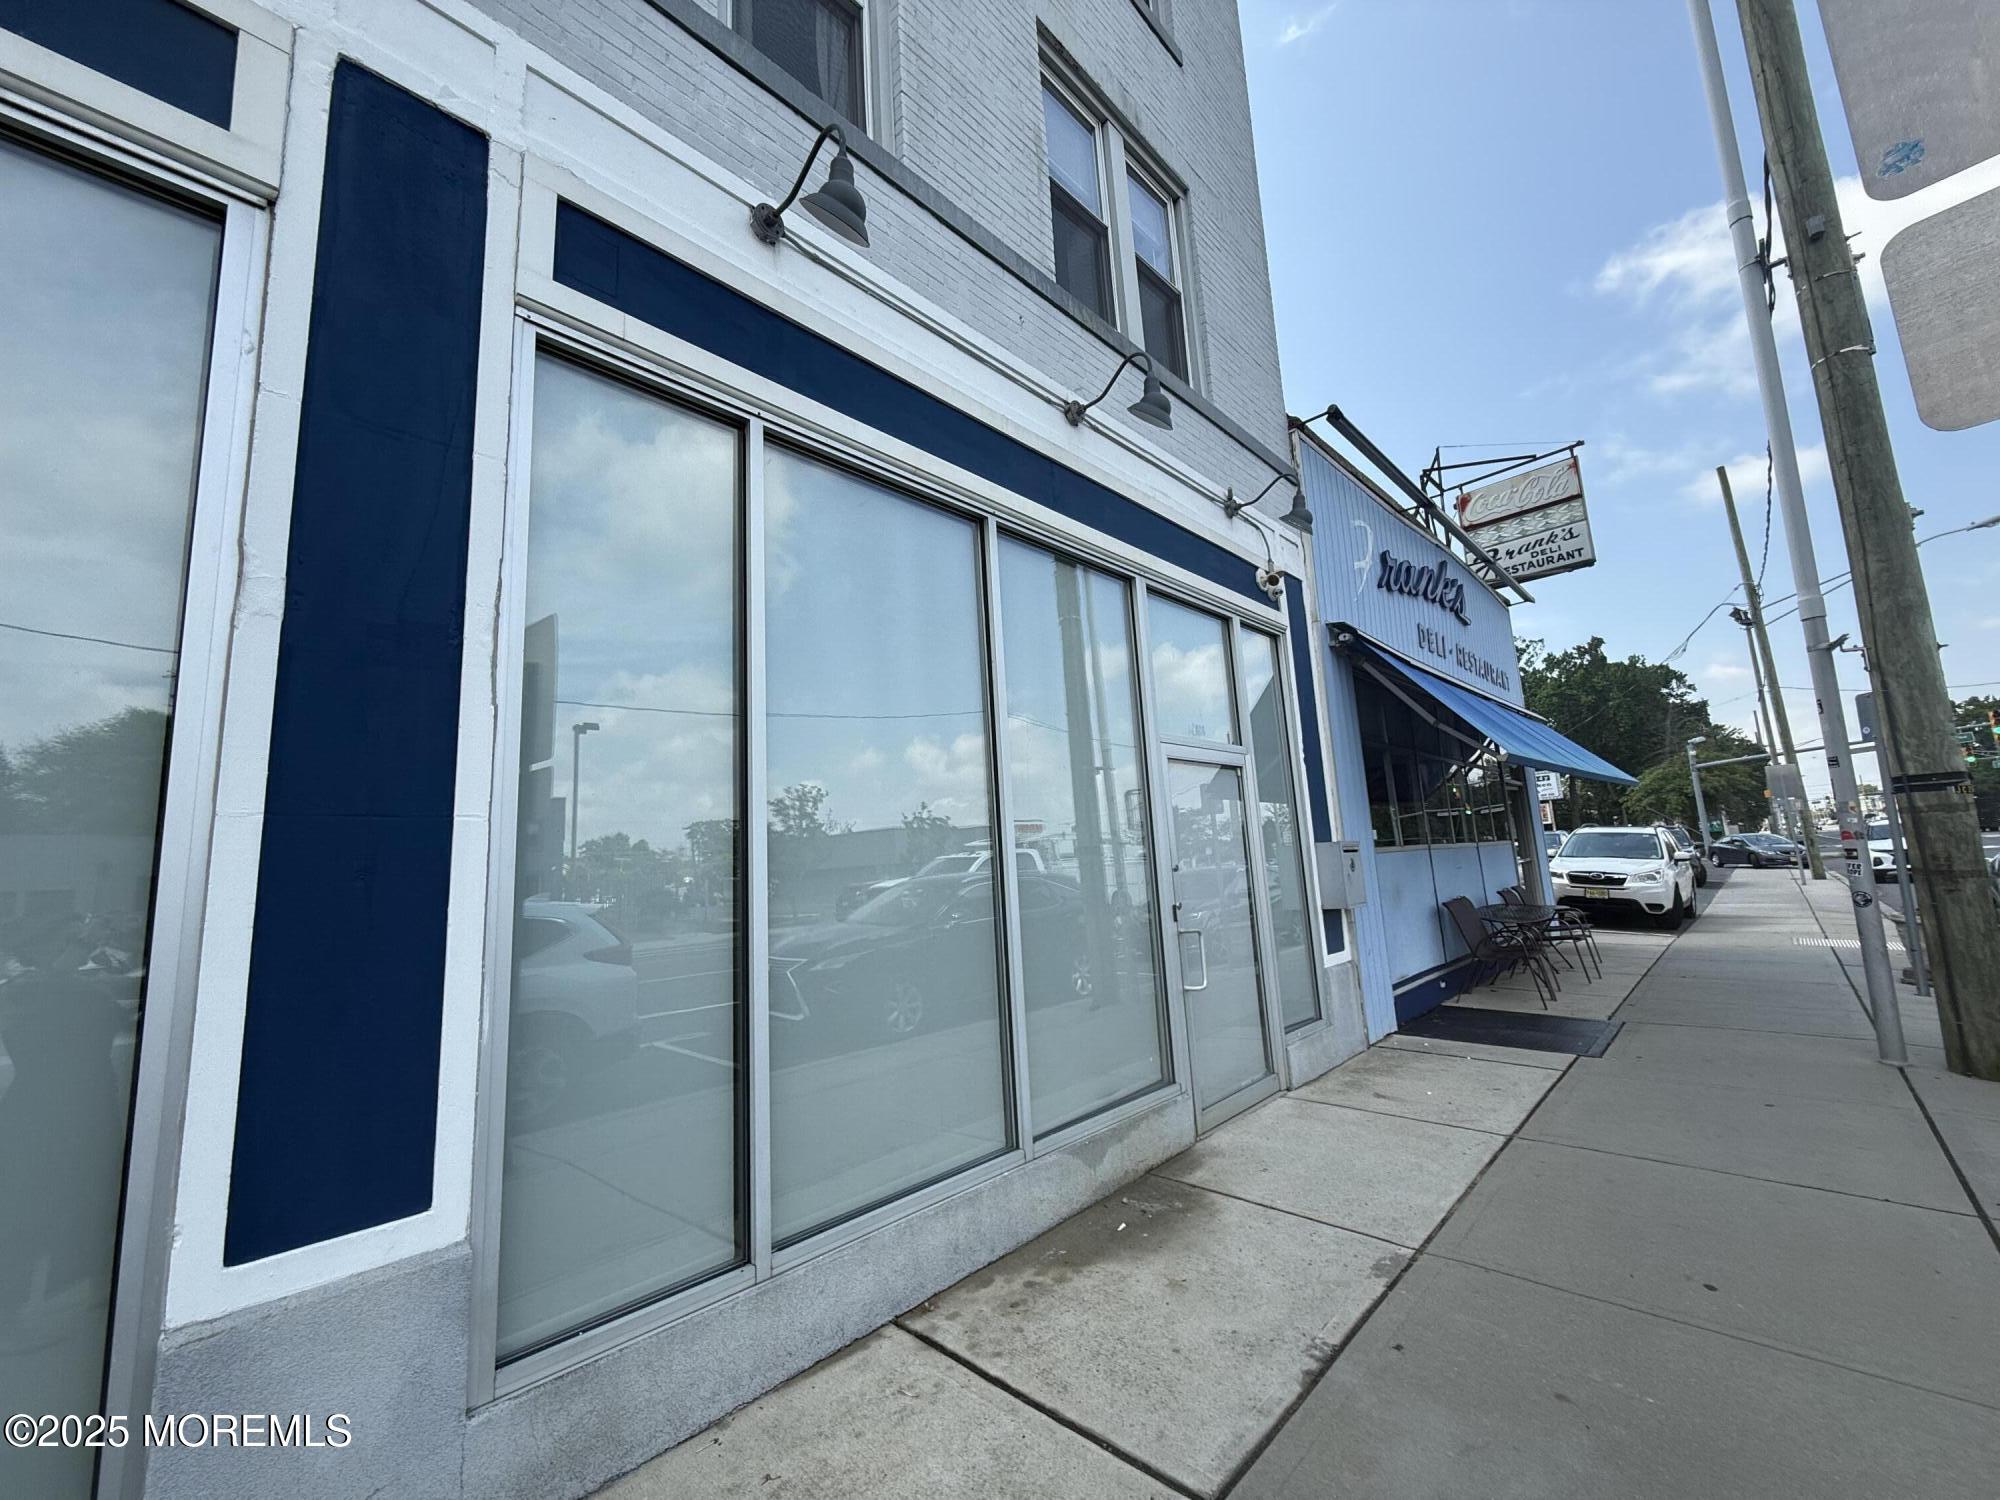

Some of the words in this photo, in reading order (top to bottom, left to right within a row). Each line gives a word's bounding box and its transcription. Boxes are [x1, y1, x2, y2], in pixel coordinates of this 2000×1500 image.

[1503, 548, 1584, 575] ESTAURANT
[1531, 545, 1562, 559] DELI
[1417, 623, 1447, 660] DELI
[1455, 642, 1510, 692] RESTAURANT
